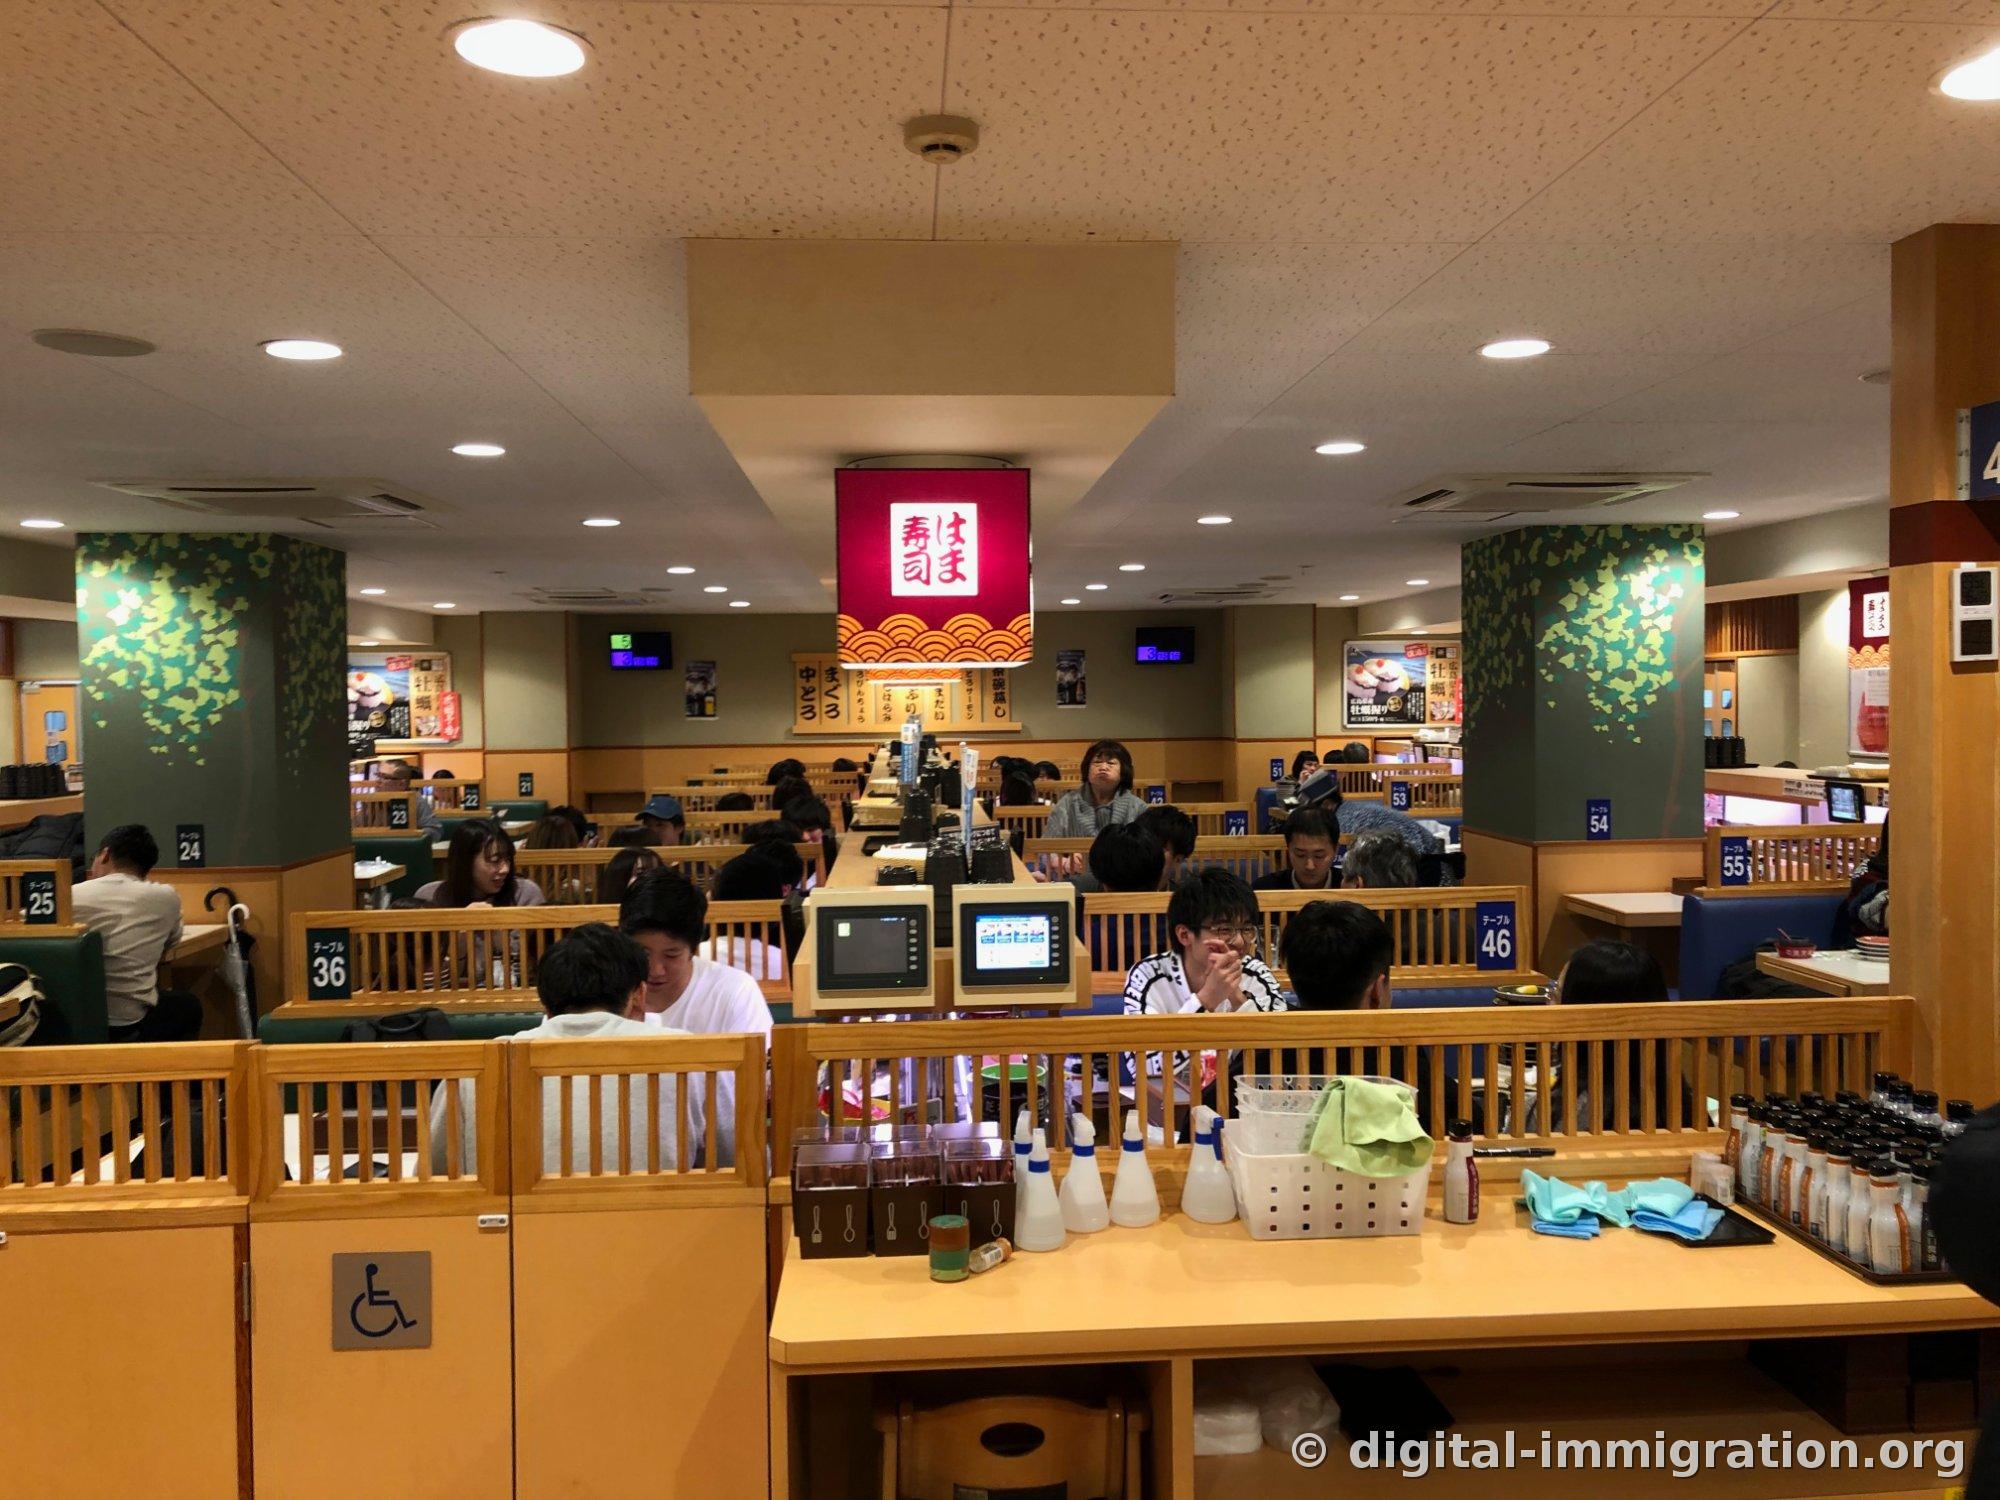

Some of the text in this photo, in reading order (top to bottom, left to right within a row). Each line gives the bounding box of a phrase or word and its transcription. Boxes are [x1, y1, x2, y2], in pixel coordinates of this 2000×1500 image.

[902, 515, 931, 586] 寿司
[937, 511, 967, 584] はま
[801, 666, 817, 720] 中とろ
[824, 666, 841, 719] まぐろ
[1272, 767, 1283, 778] 51
[465, 794, 478, 807] 22
[1393, 792, 1406, 806] 53
[392, 810, 407, 825] 23
[1590, 815, 1609, 833] 54
[179, 841, 200, 861] 24
[1723, 855, 1744, 877] 55
[29, 892, 54, 915] 25
[1482, 914, 1511, 926] テーブル
[313, 942, 345, 954] テーブル
[1481, 928, 1512, 958] 46
[313, 956, 346, 987] 36
